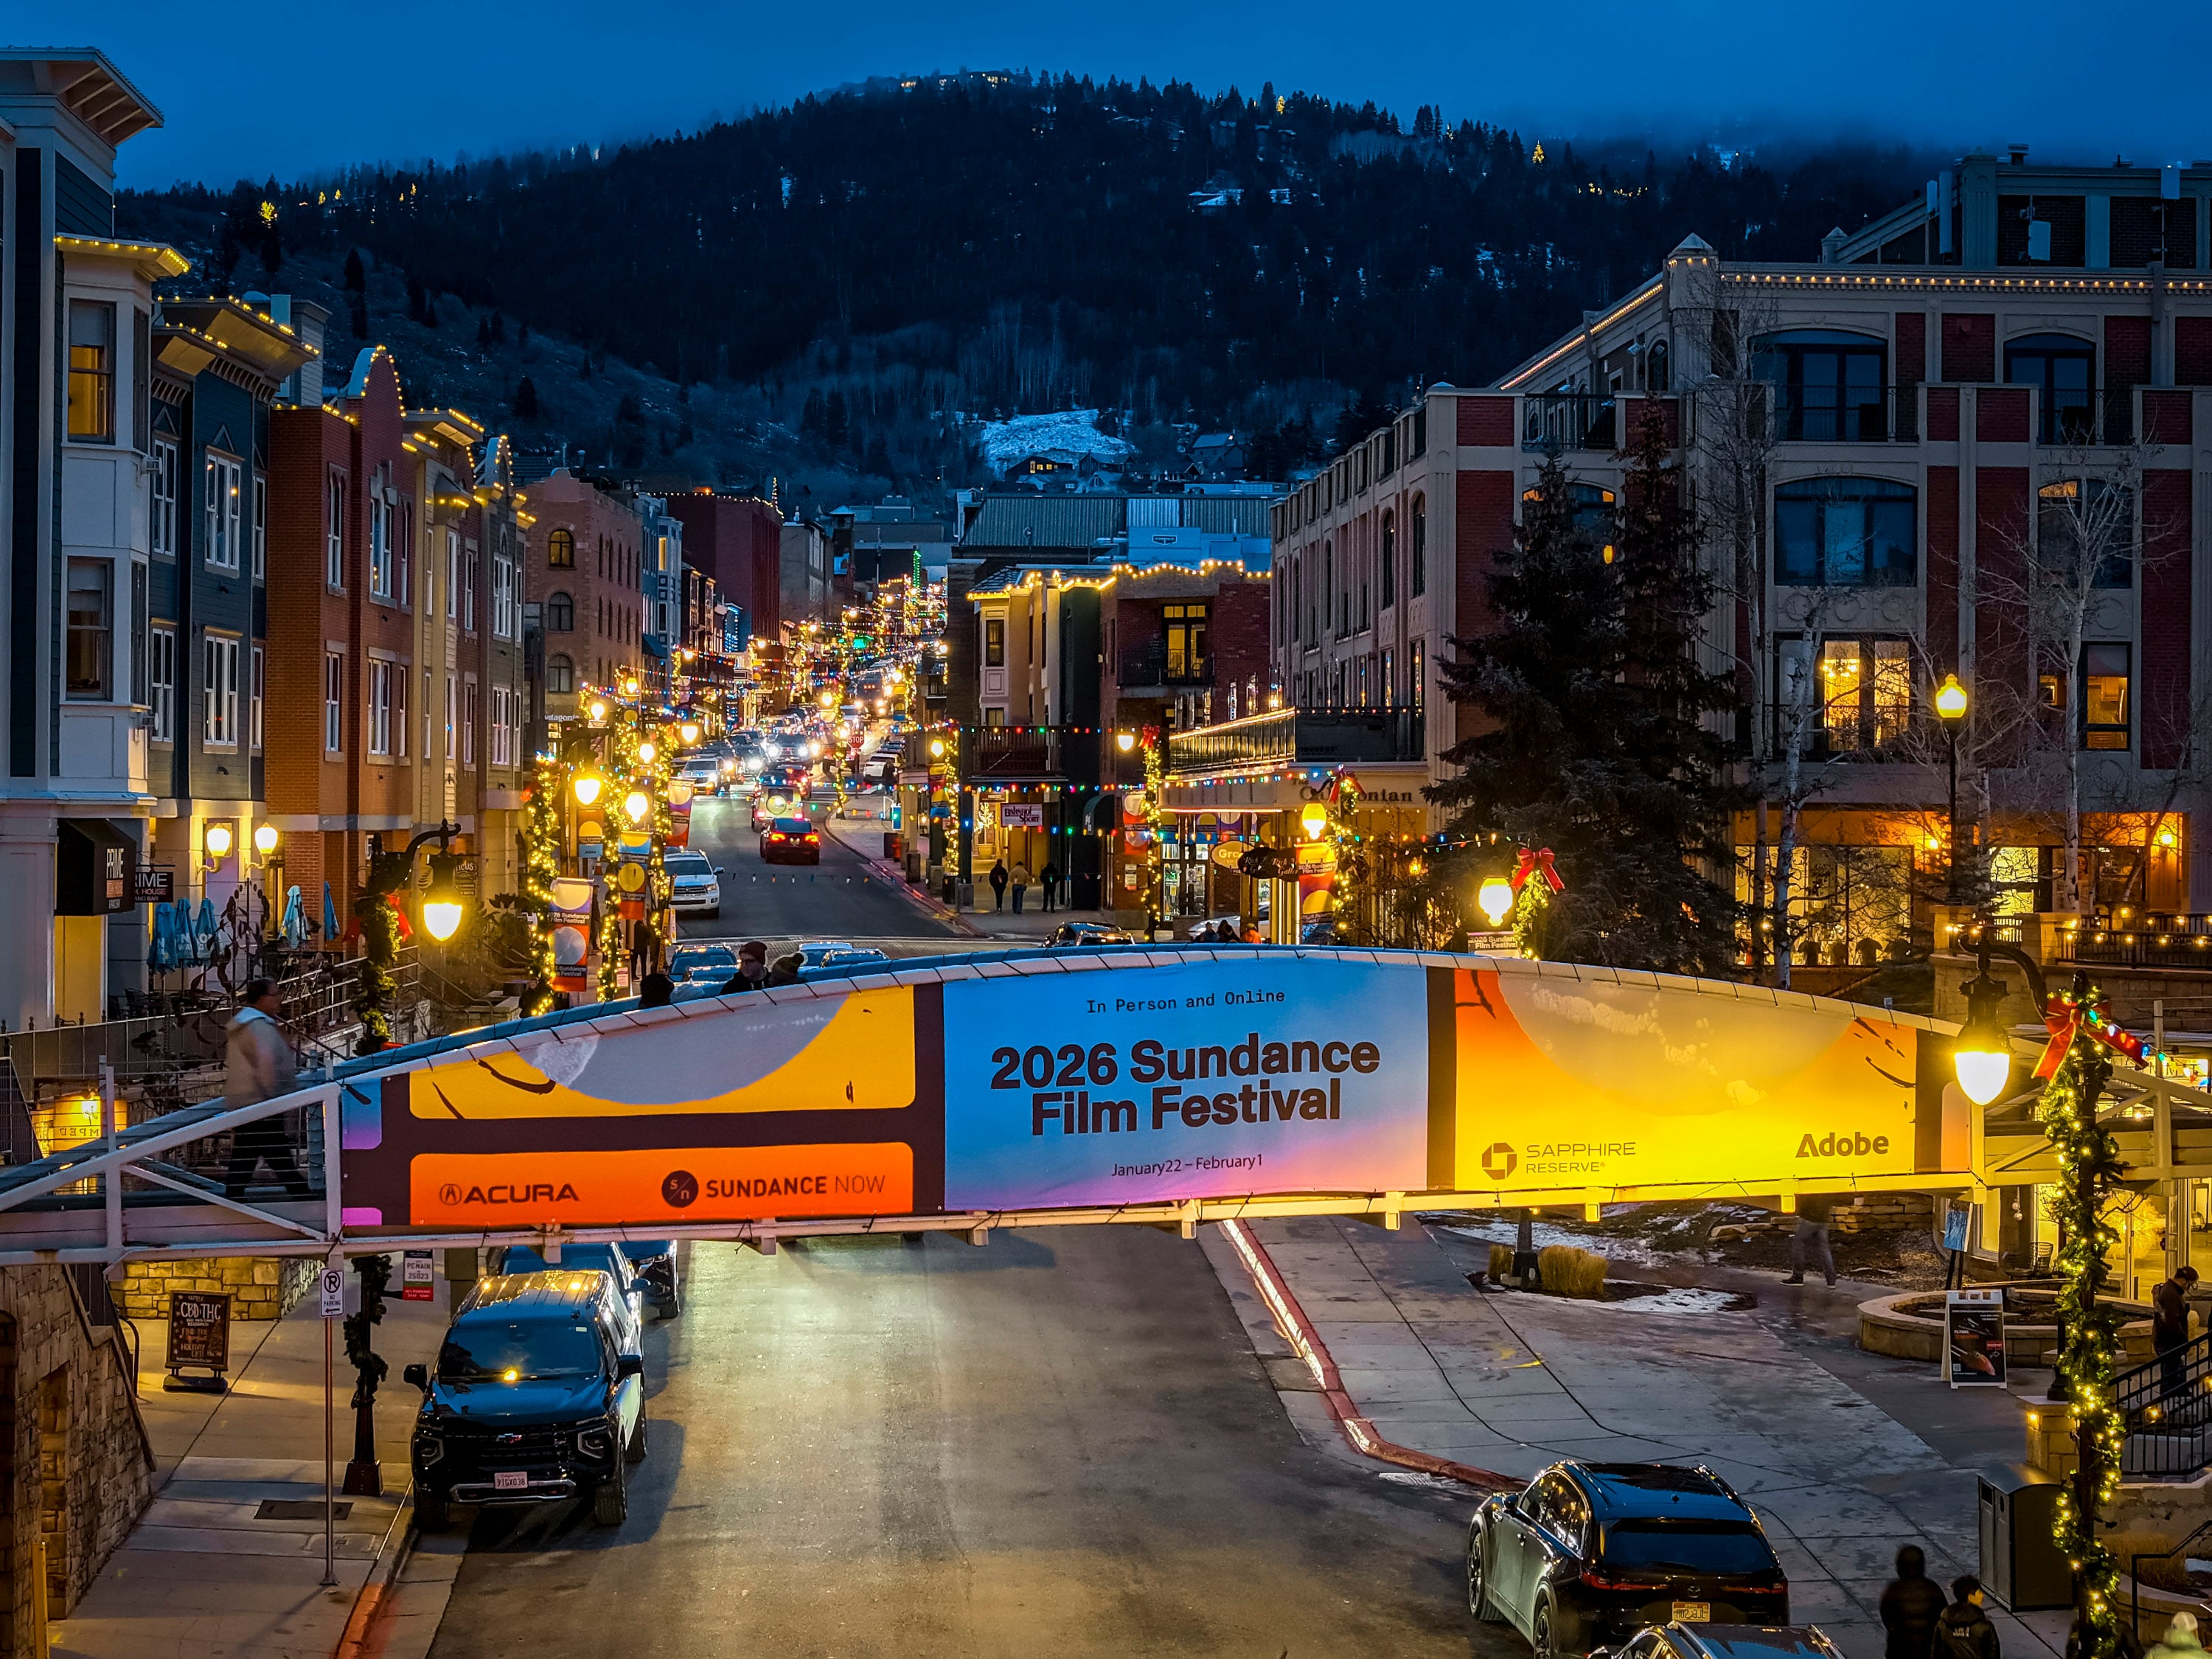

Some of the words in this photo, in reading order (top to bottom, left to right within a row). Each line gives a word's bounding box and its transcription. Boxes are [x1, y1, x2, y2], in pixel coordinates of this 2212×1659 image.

[135, 873, 167, 887] IME
[1087, 1000, 1106, 1013] In
[1116, 998, 1177, 1012] Person
[1186, 993, 1215, 1007] and
[1225, 989, 1285, 1005] Online
[990, 1042, 1118, 1089] 2026
[1130, 1032, 1380, 1083] Sundance
[1032, 1091, 1137, 1135] Film
[1152, 1078, 1340, 1130] Festival
[1526, 1142, 1636, 1158] SAPPHIRE
[1795, 1131, 1889, 1158] Adobe
[463, 1183, 580, 1204] ACURA
[706, 1176, 827, 1198] SUNDANCE
[835, 1175, 885, 1194] NOW
[323, 1299, 341, 1307] PARKING
